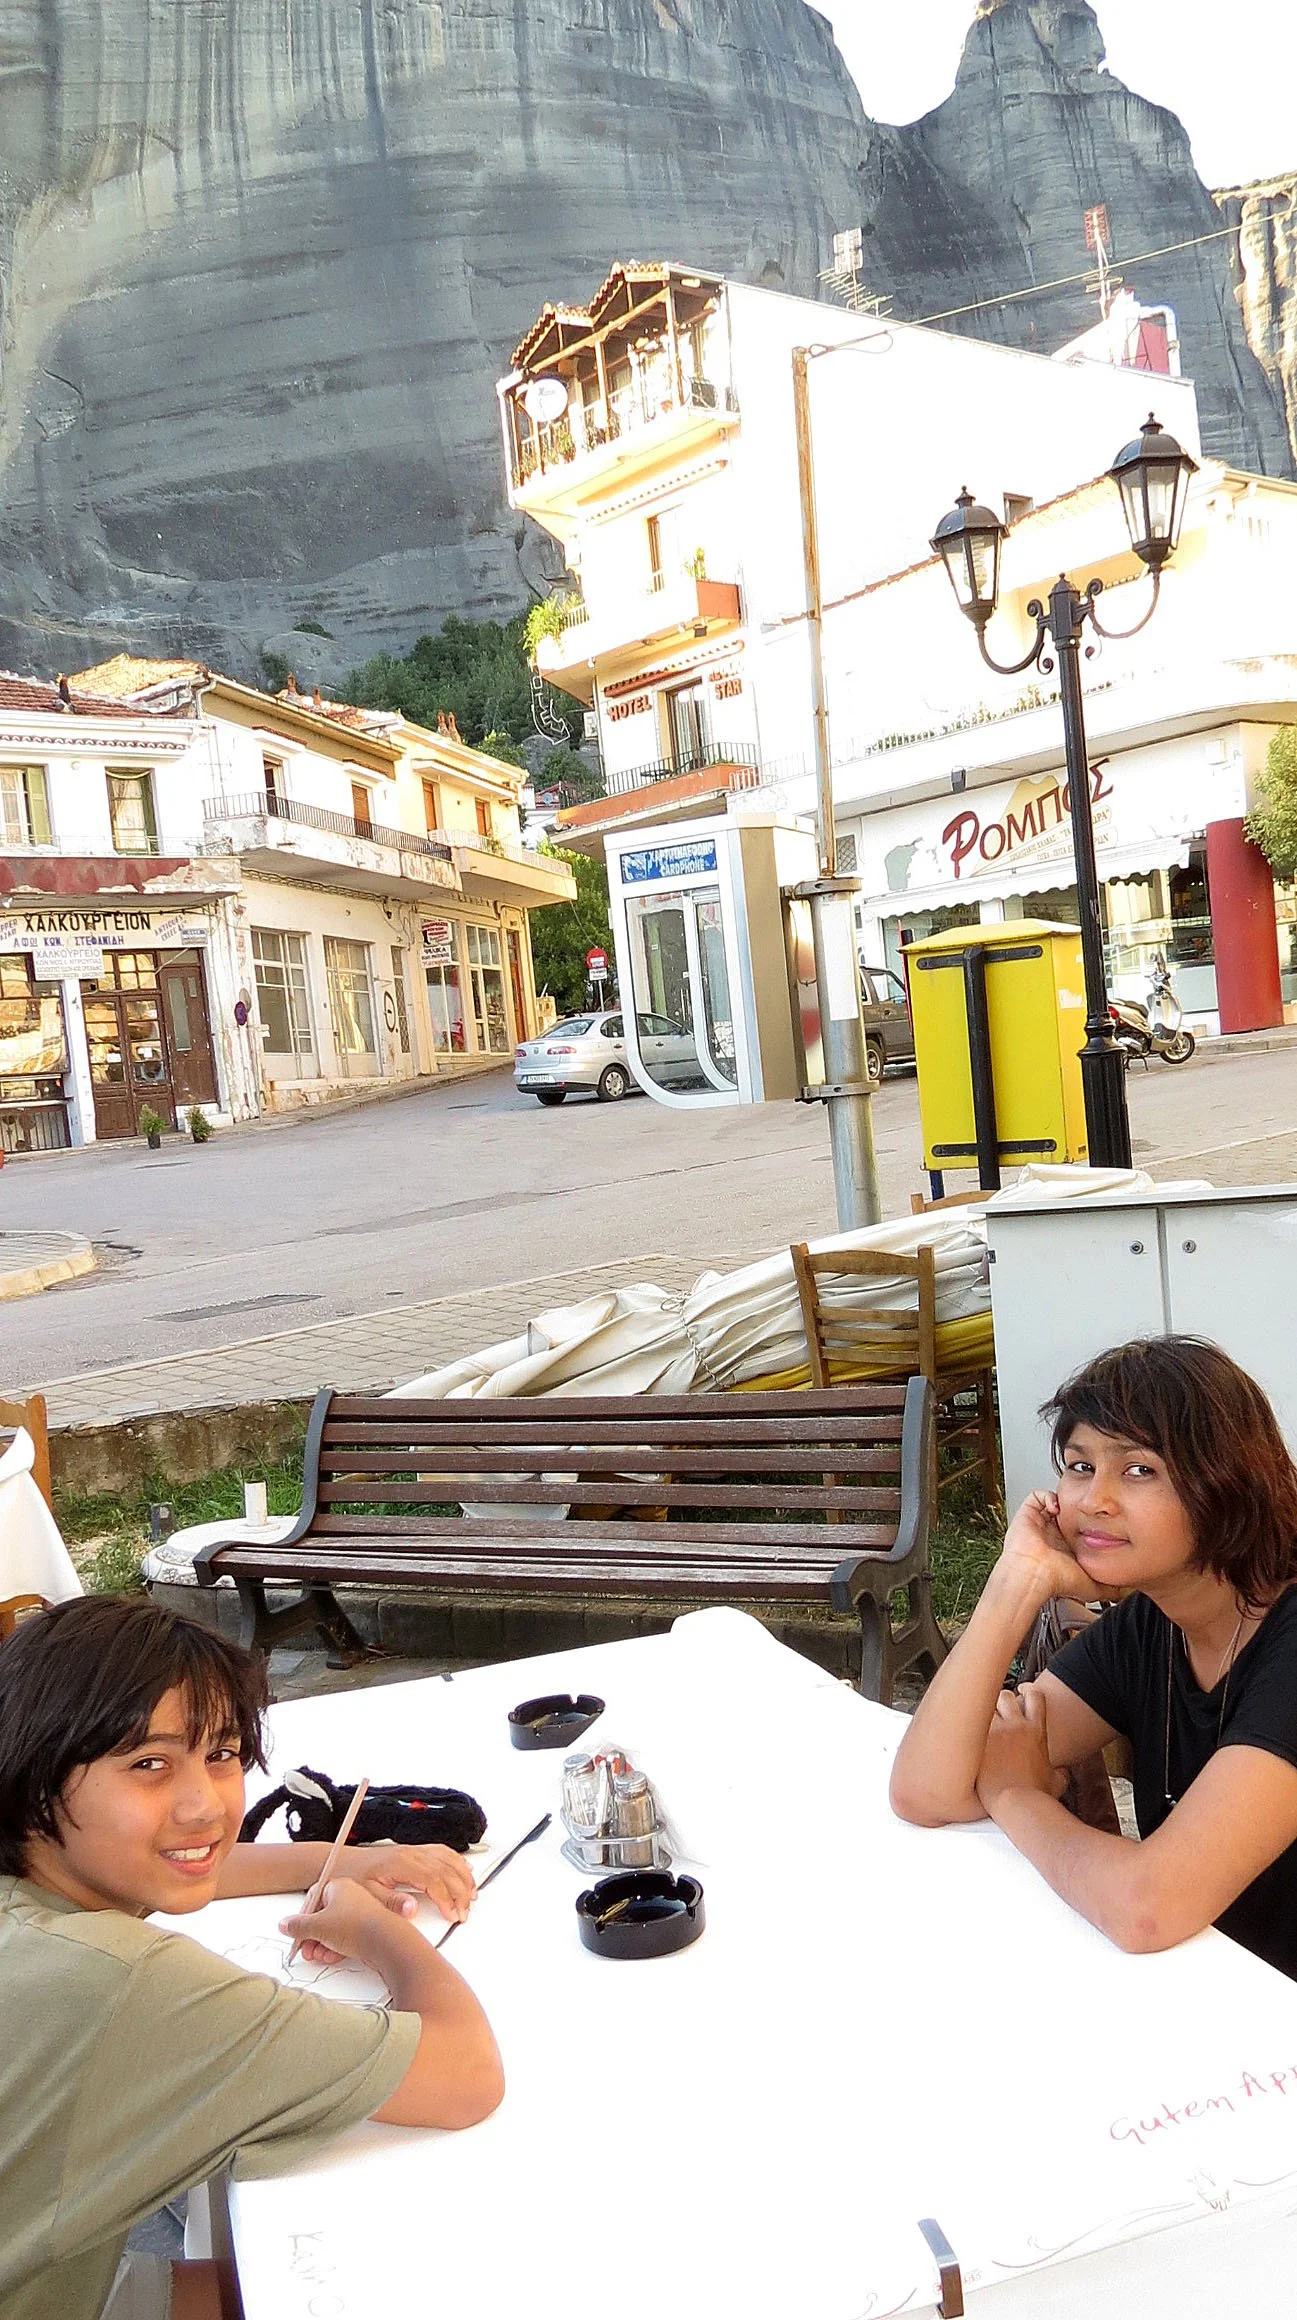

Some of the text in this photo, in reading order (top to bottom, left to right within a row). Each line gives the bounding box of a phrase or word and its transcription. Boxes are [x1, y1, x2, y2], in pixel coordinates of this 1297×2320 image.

[714, 678, 742, 700] STAR
[608, 694, 653, 722] HOTEL
[660, 856, 705, 878] CARDPHONE
[24, 912, 151, 932] ΧΑΛΚΟΥΡΓΕΙΟΝ
[1109, 2096, 1236, 2145] Guten
